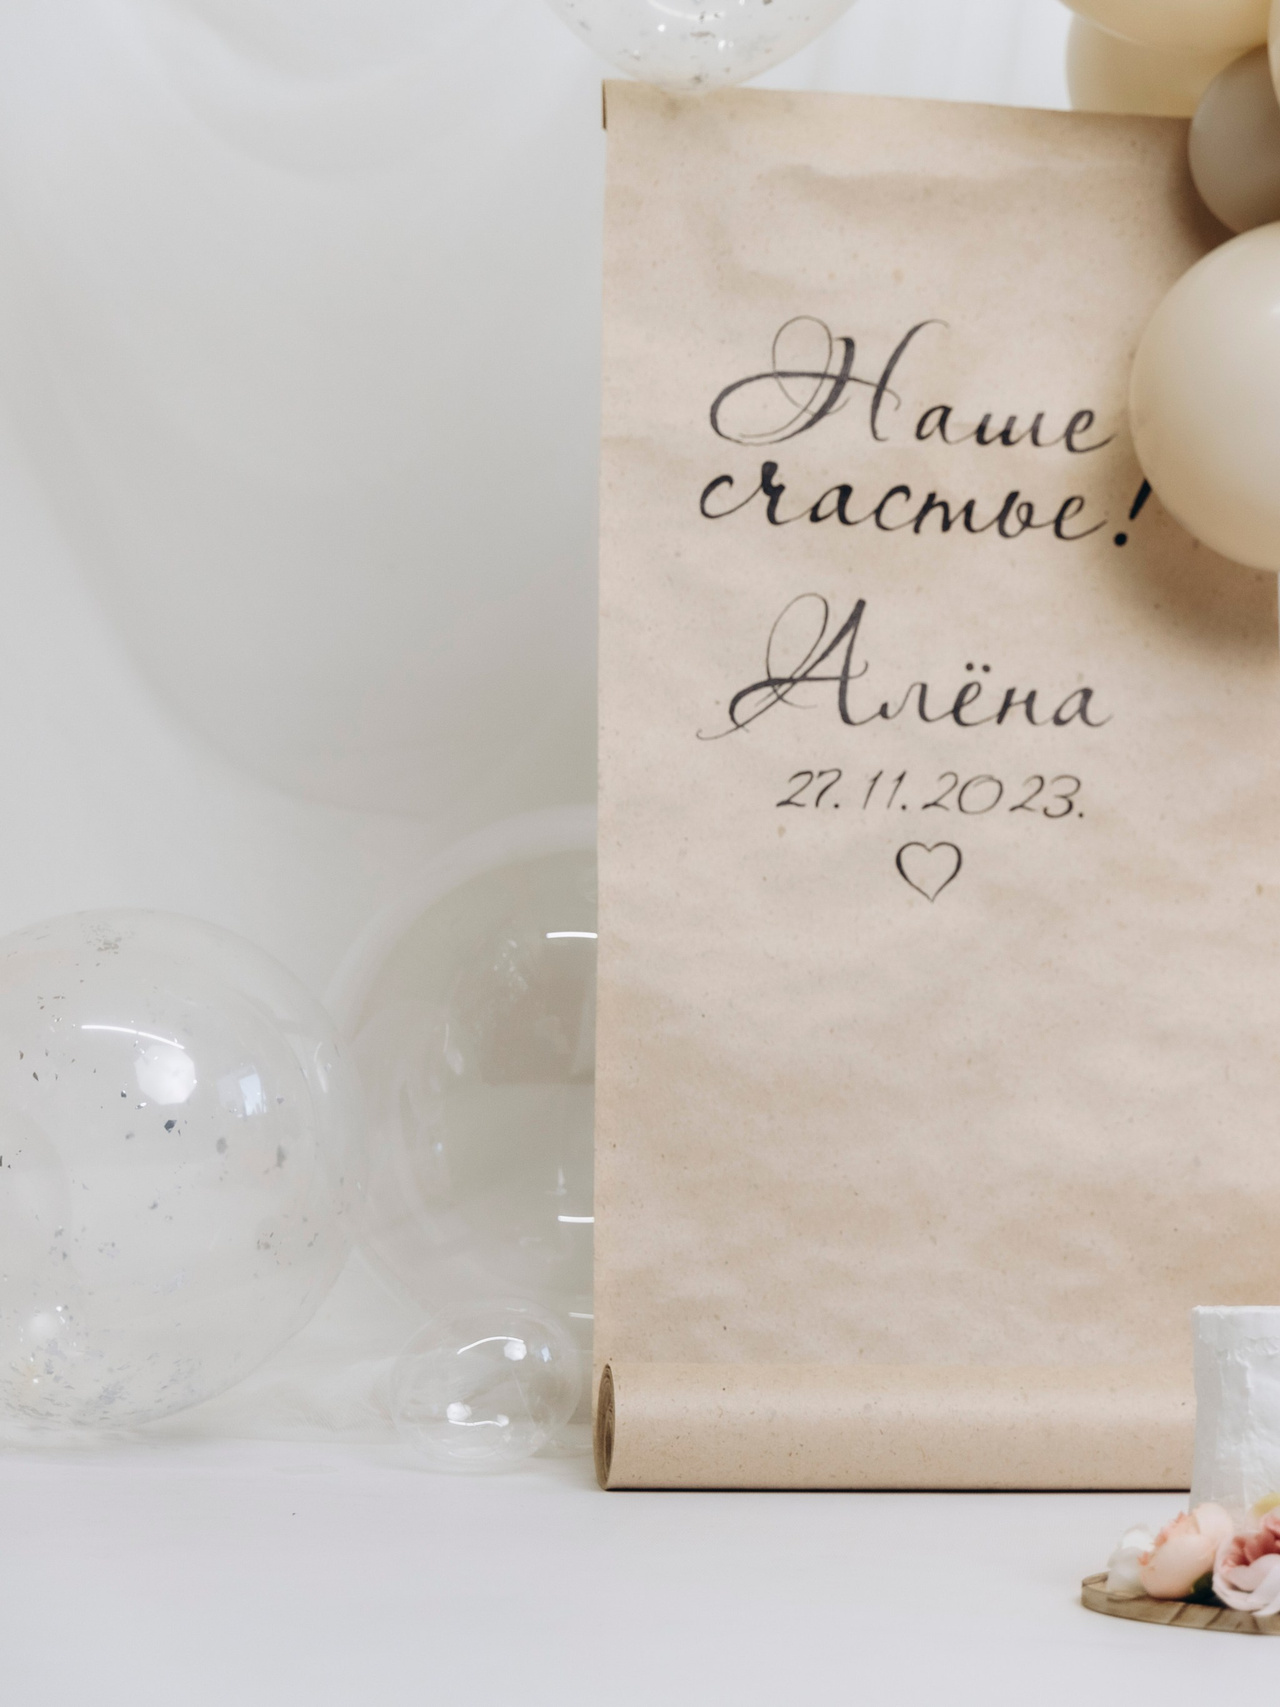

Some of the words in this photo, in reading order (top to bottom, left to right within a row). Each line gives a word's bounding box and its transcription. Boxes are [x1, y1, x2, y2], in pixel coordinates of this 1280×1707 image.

[708, 315, 1118, 454] Наше
[699, 460, 1153, 548] счастье!
[695, 592, 1114, 741] Алёна
